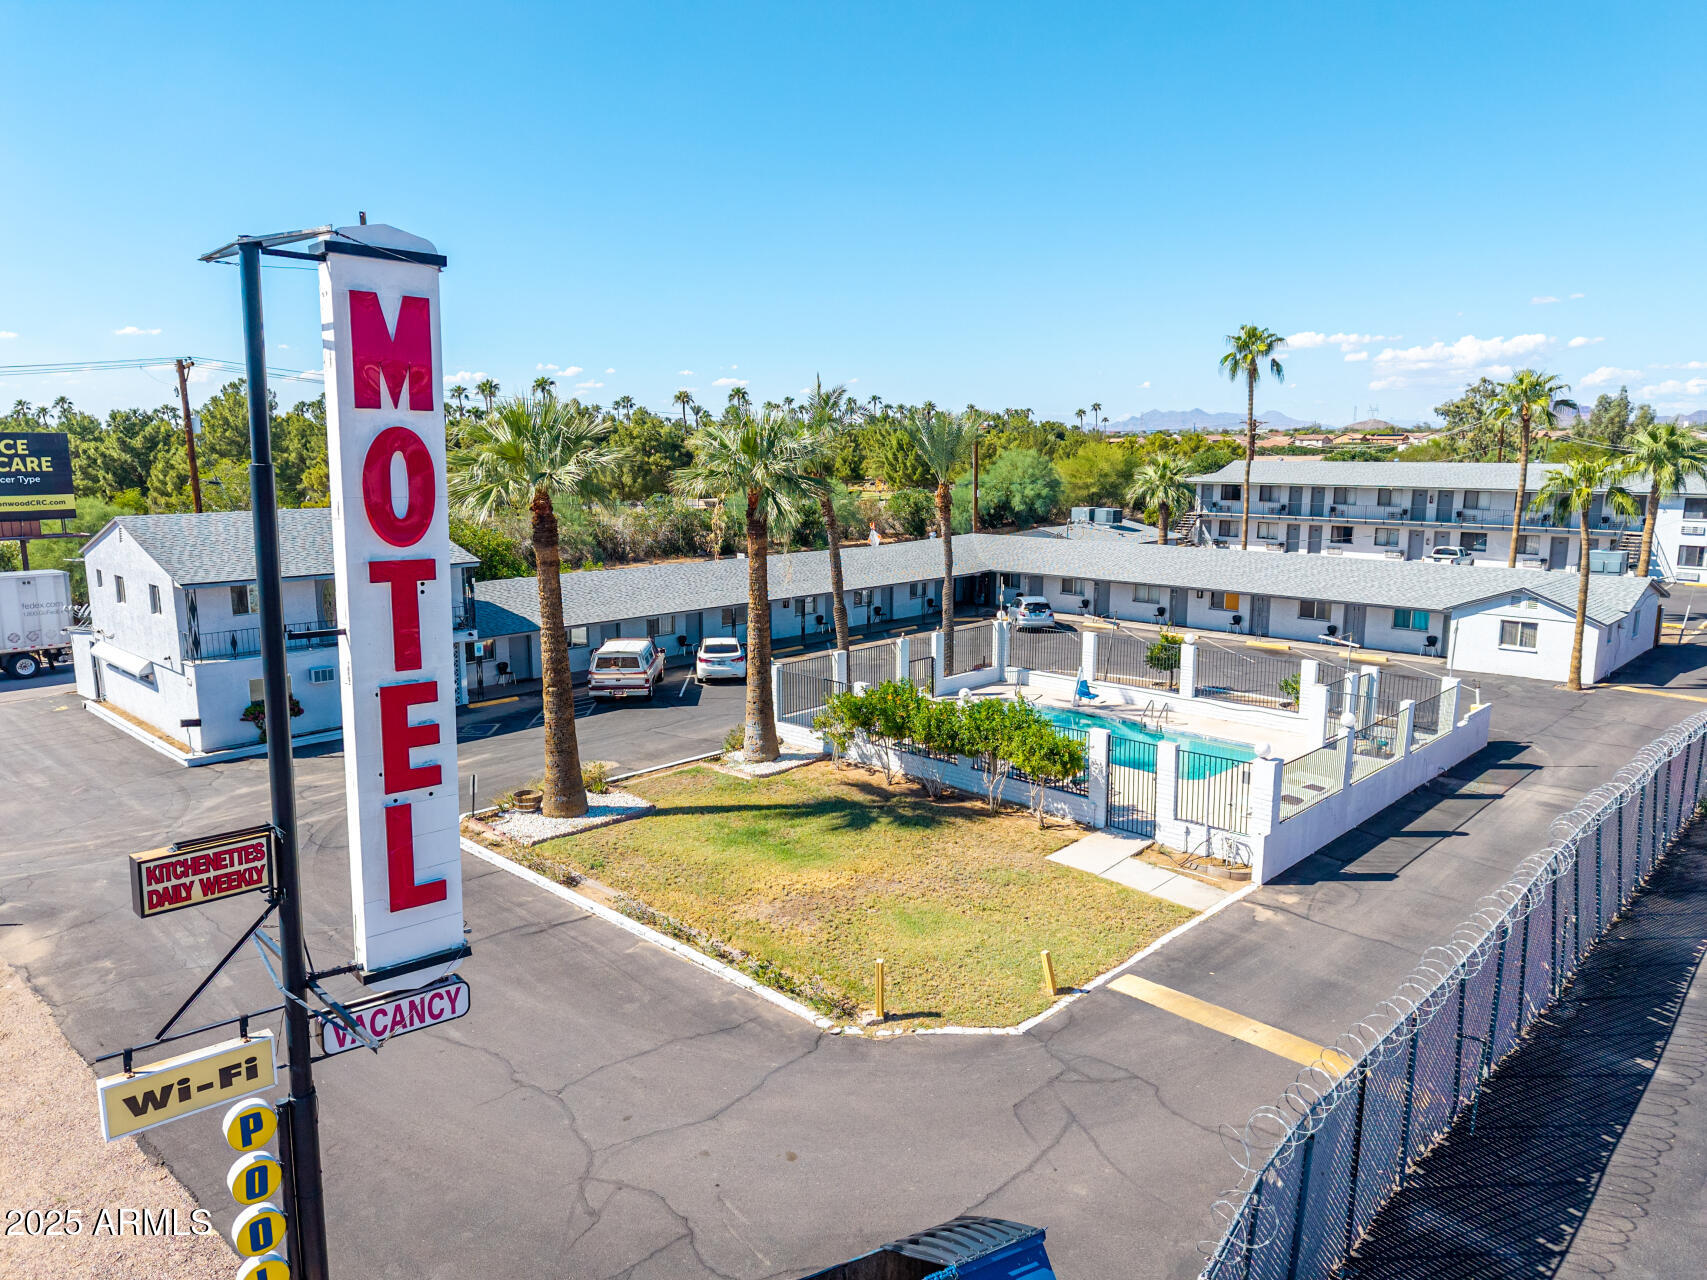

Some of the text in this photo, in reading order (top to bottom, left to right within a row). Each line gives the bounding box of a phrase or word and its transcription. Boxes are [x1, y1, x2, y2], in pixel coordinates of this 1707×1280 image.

[0, 439, 29, 454] CE
[0, 457, 53, 472] CARE
[17, 475, 41, 485] Type
[347, 289, 448, 913] MOTEL
[145, 842, 266, 887] KITCHENETTES
[146, 863, 267, 911] DAILY WEEKLY
[122, 1056, 259, 1118] Wi-Fi
